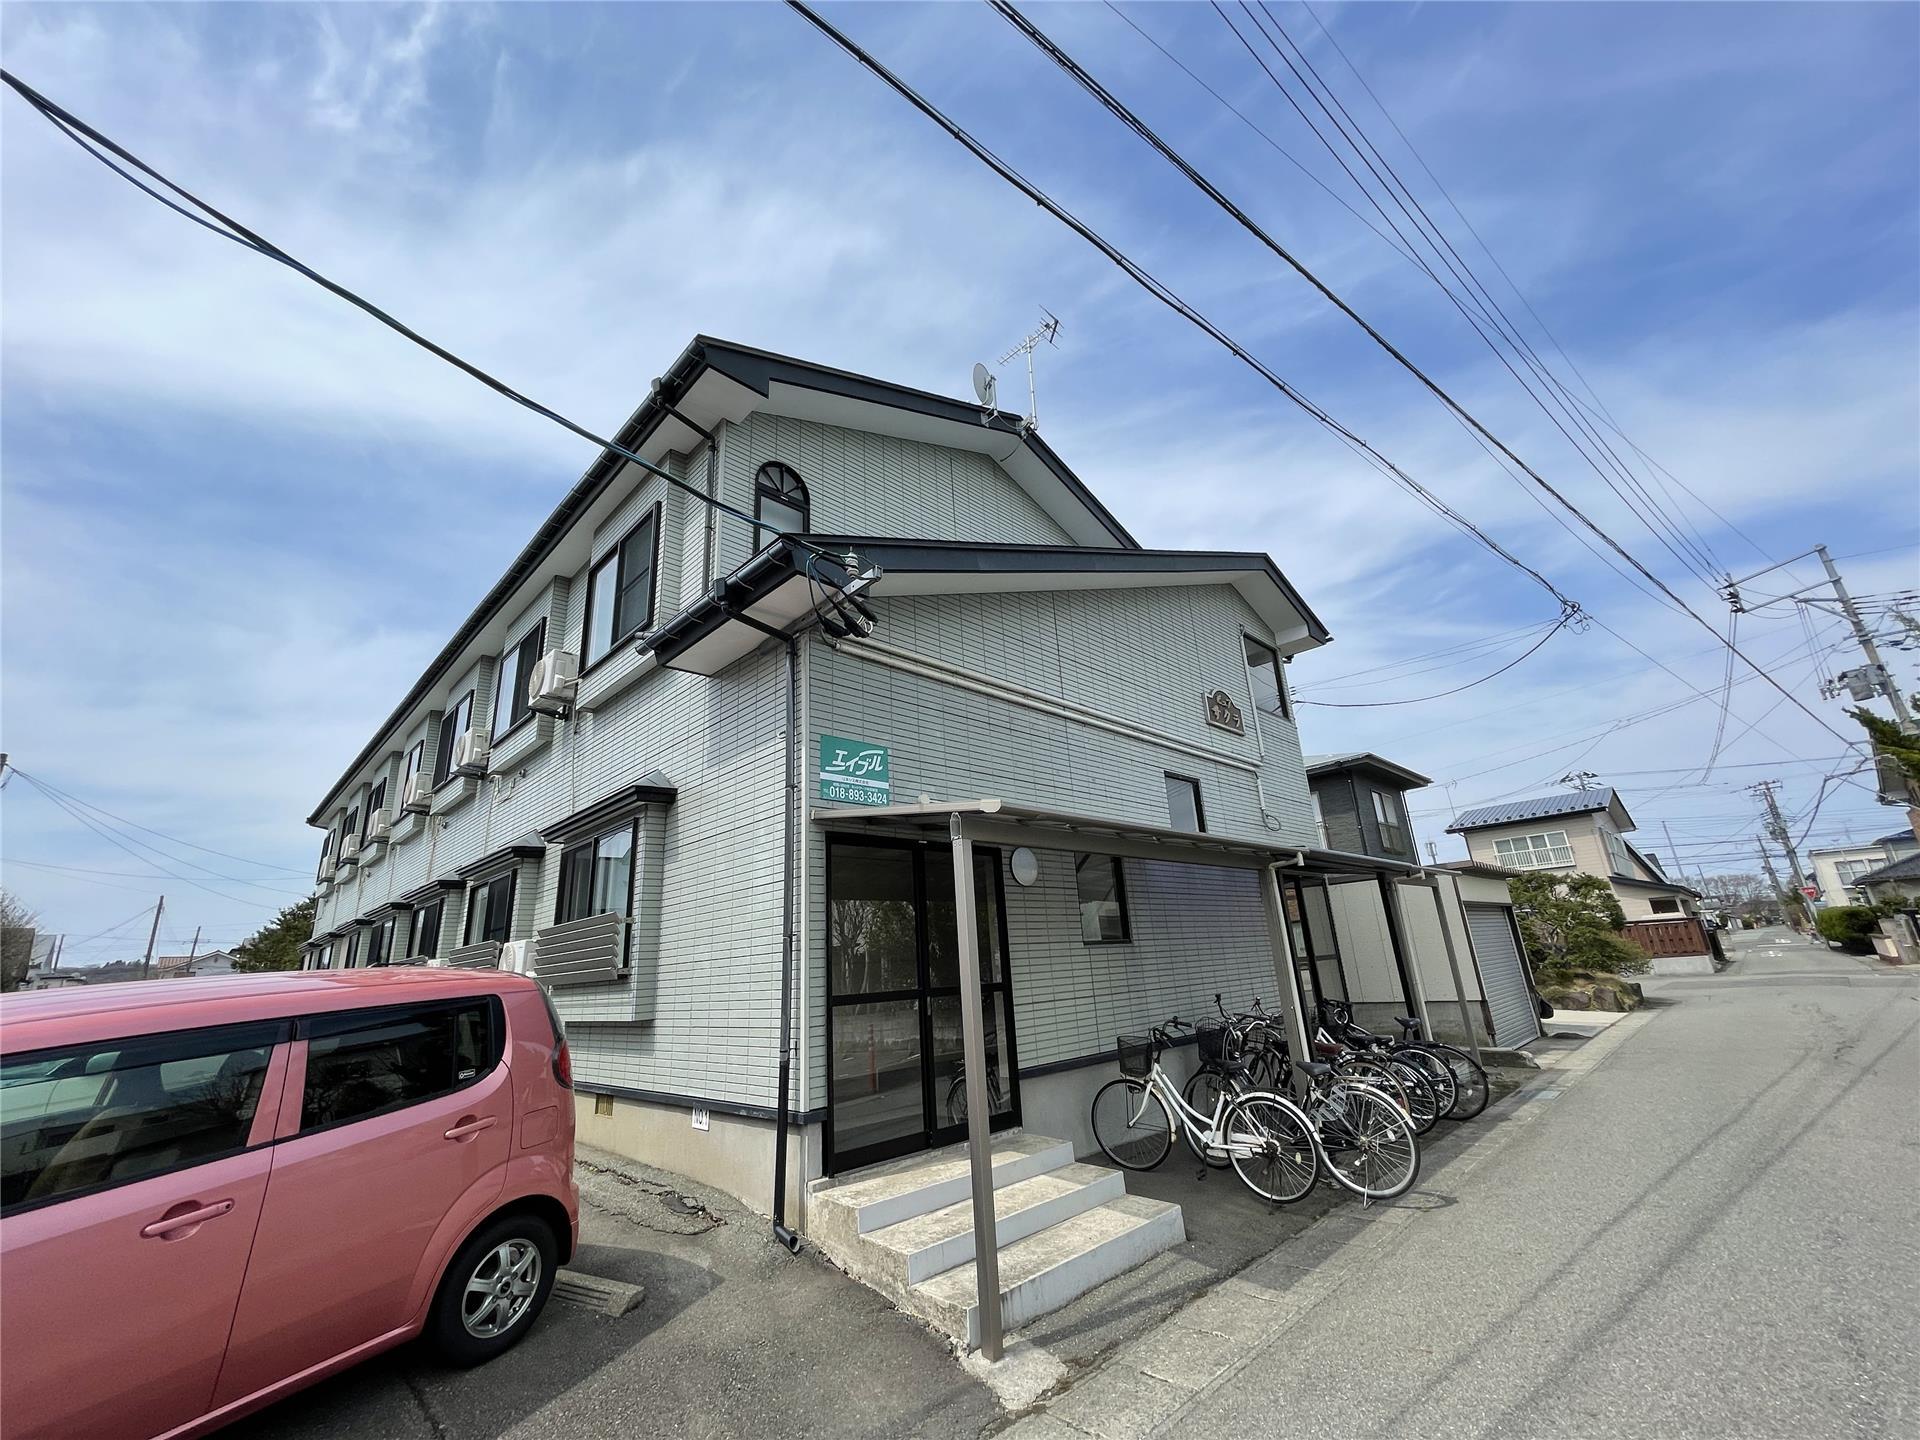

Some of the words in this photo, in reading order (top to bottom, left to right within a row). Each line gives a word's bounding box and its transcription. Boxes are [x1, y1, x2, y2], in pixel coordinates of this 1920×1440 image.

[825, 749, 884, 776] エイブル
[829, 786, 887, 804] 018-893-3424
